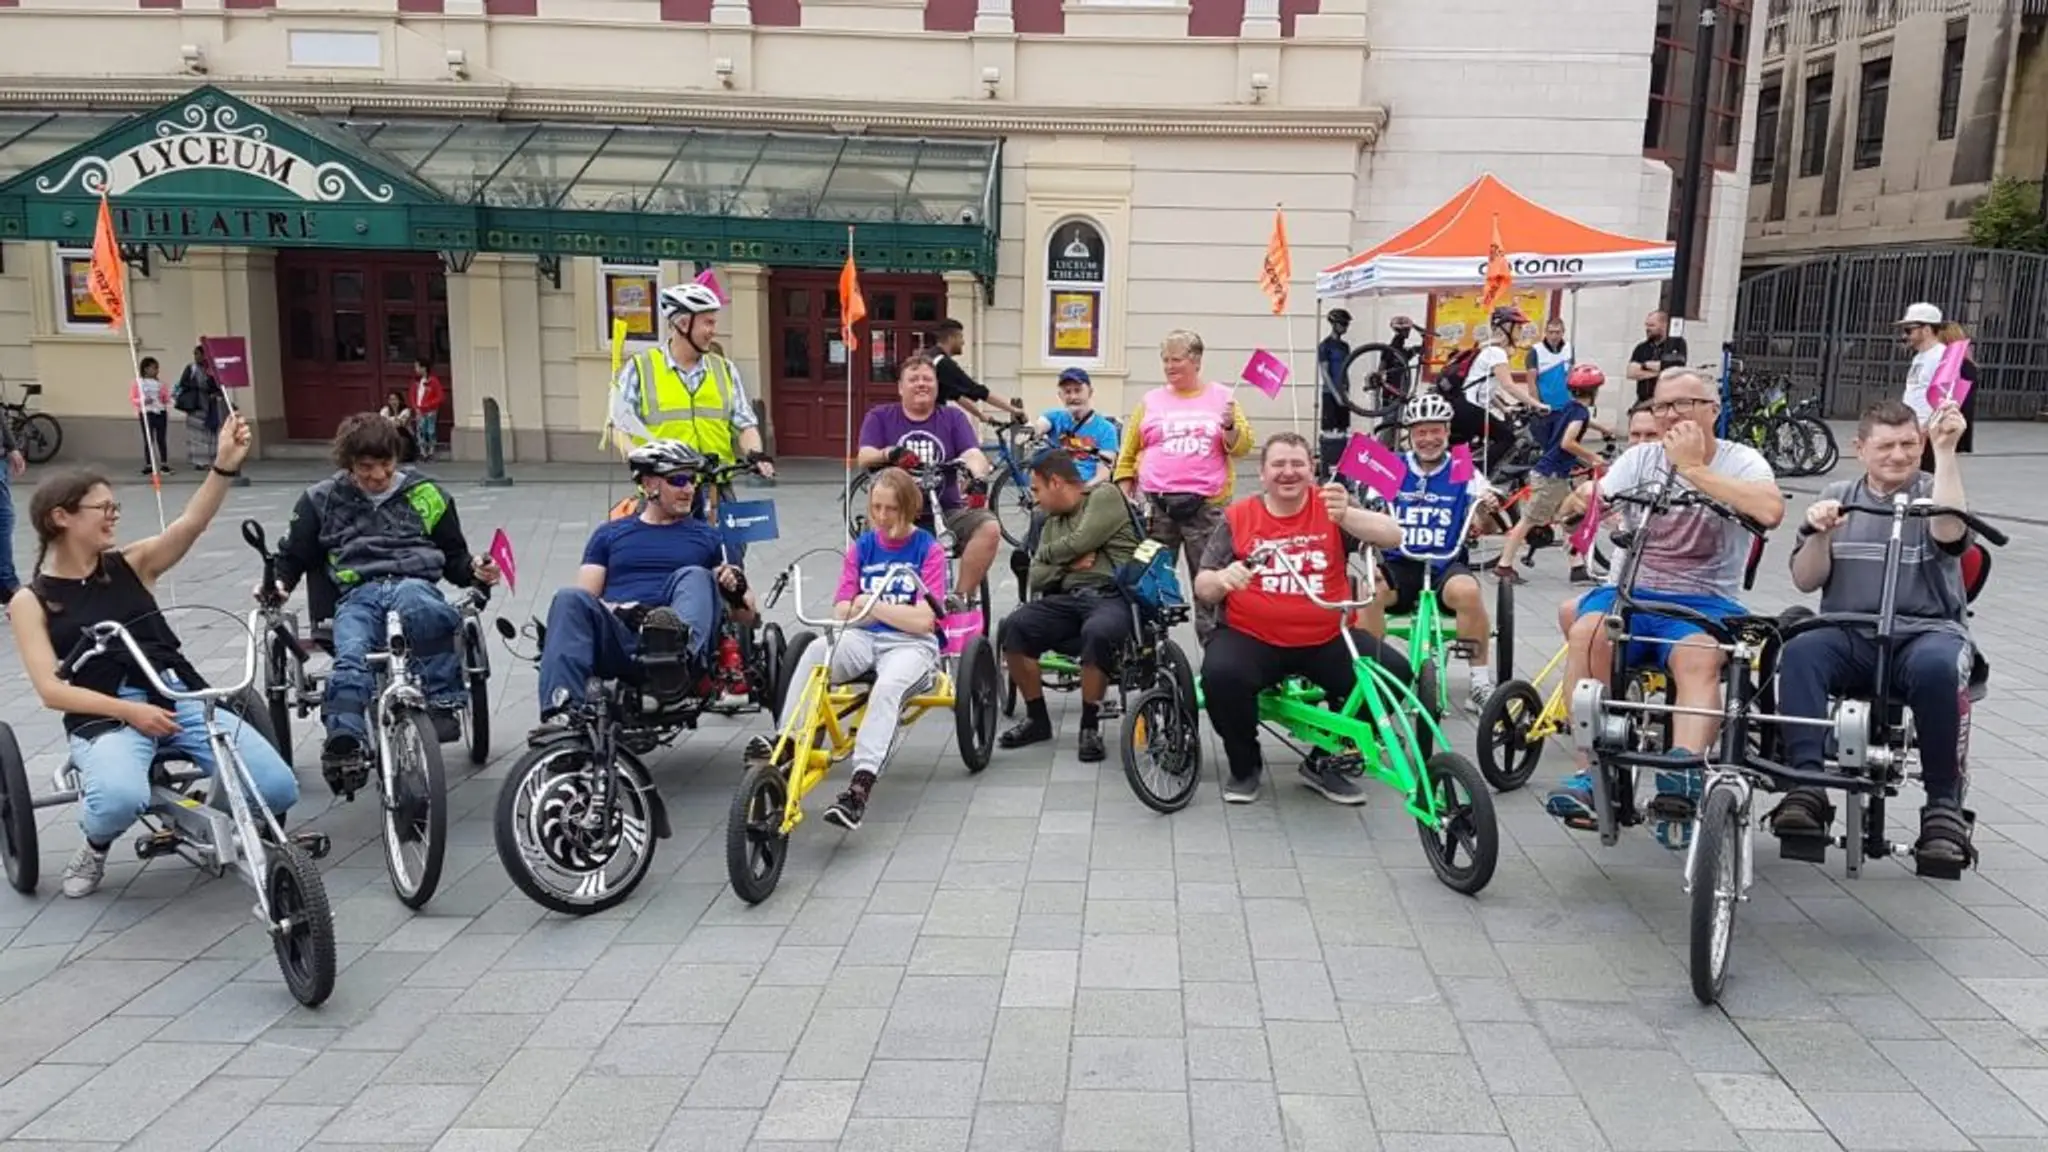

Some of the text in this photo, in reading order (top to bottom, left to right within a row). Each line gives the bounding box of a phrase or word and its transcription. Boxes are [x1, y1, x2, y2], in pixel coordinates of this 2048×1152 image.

[128, 136, 297, 184] LYCEUM
[114, 207, 318, 239] THEATRE
[1052, 270, 1100, 280] THEATRE
[1055, 259, 1097, 270] LYCEUM
[1478, 257, 1583, 277] tonia
[1396, 505, 1452, 527] LET'S
[1261, 573, 1325, 595] RIDE
